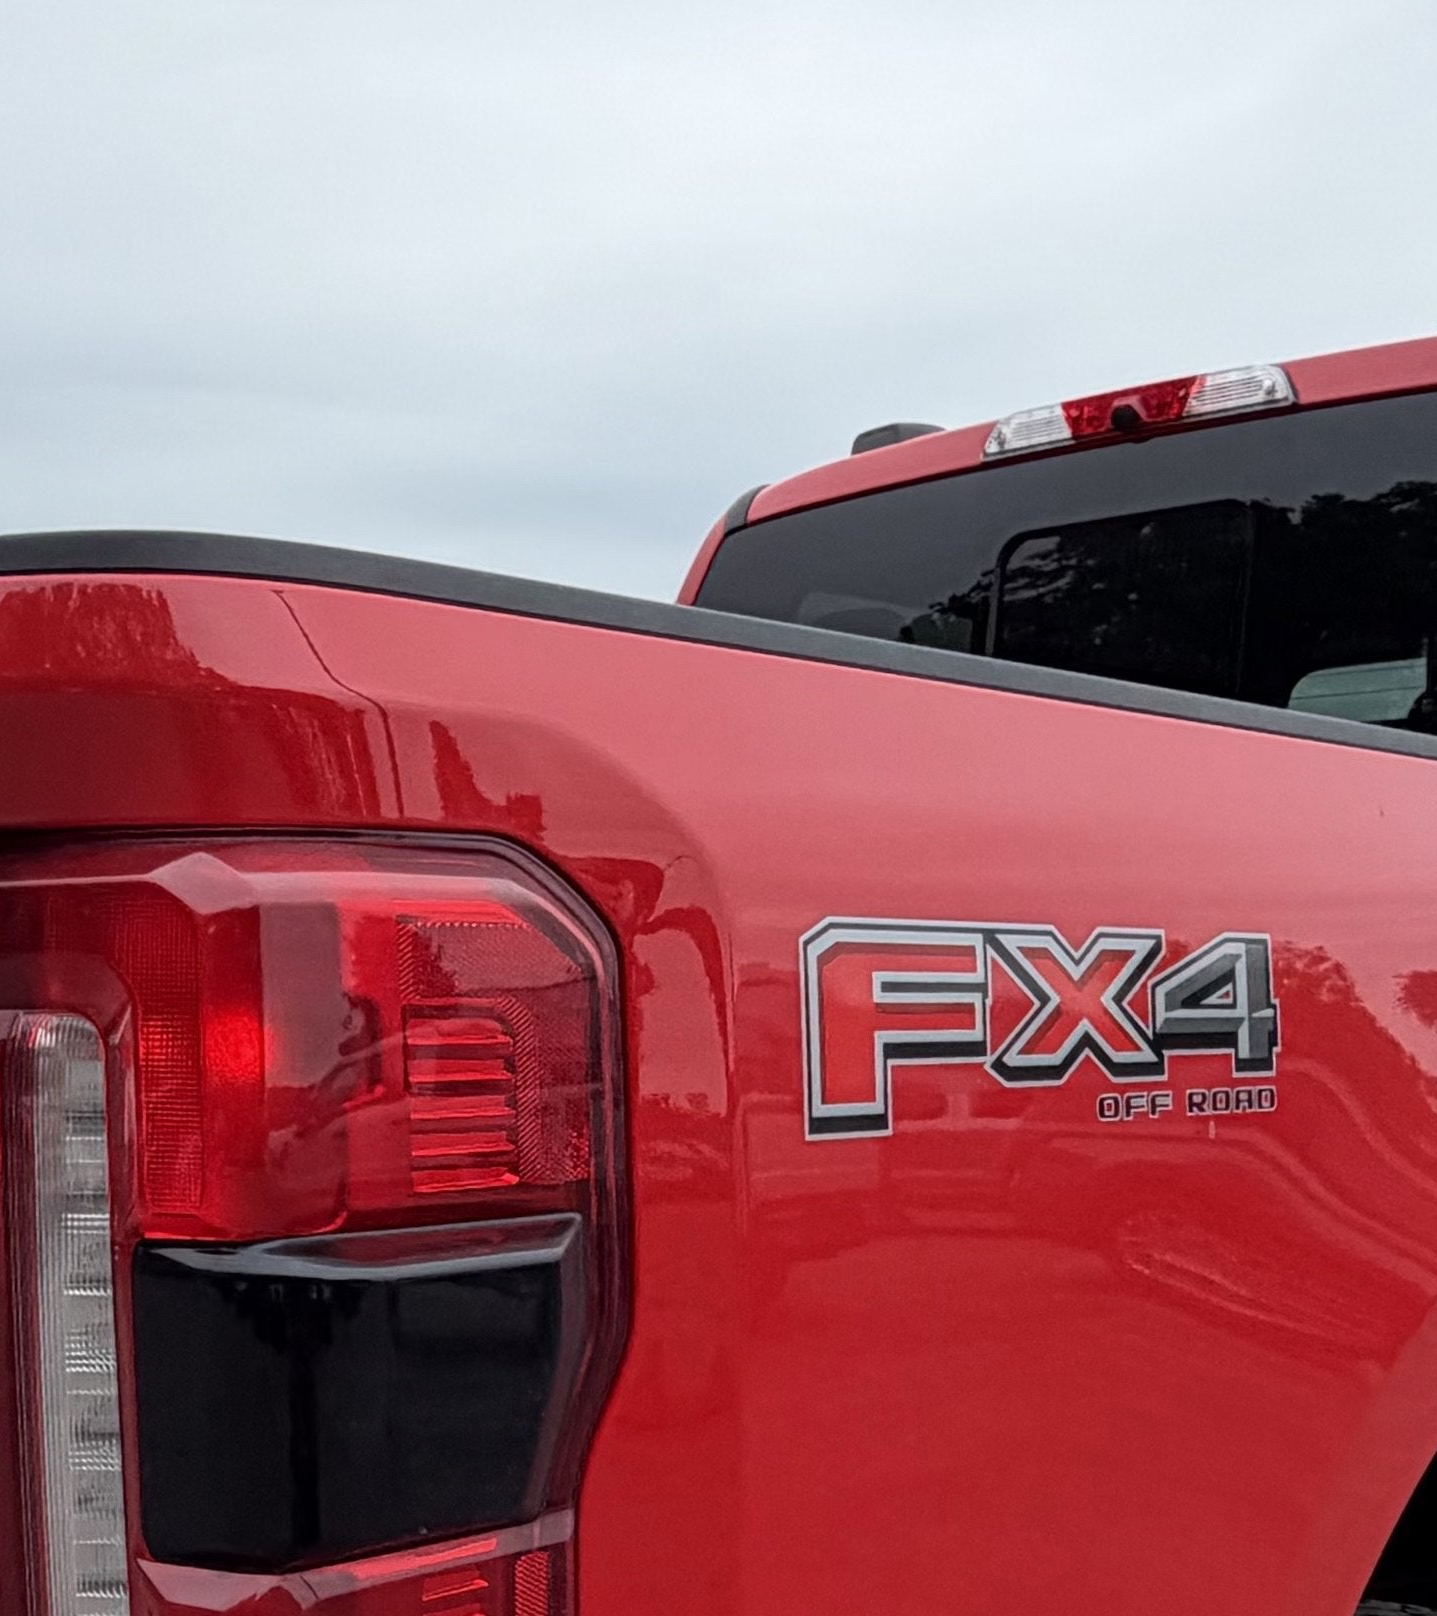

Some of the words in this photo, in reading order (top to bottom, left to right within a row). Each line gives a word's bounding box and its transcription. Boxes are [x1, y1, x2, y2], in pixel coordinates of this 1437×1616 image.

[799, 915, 1281, 1141] FX4
[1097, 1090, 1174, 1122] OFF
[1185, 1085, 1278, 1117] ROAD
